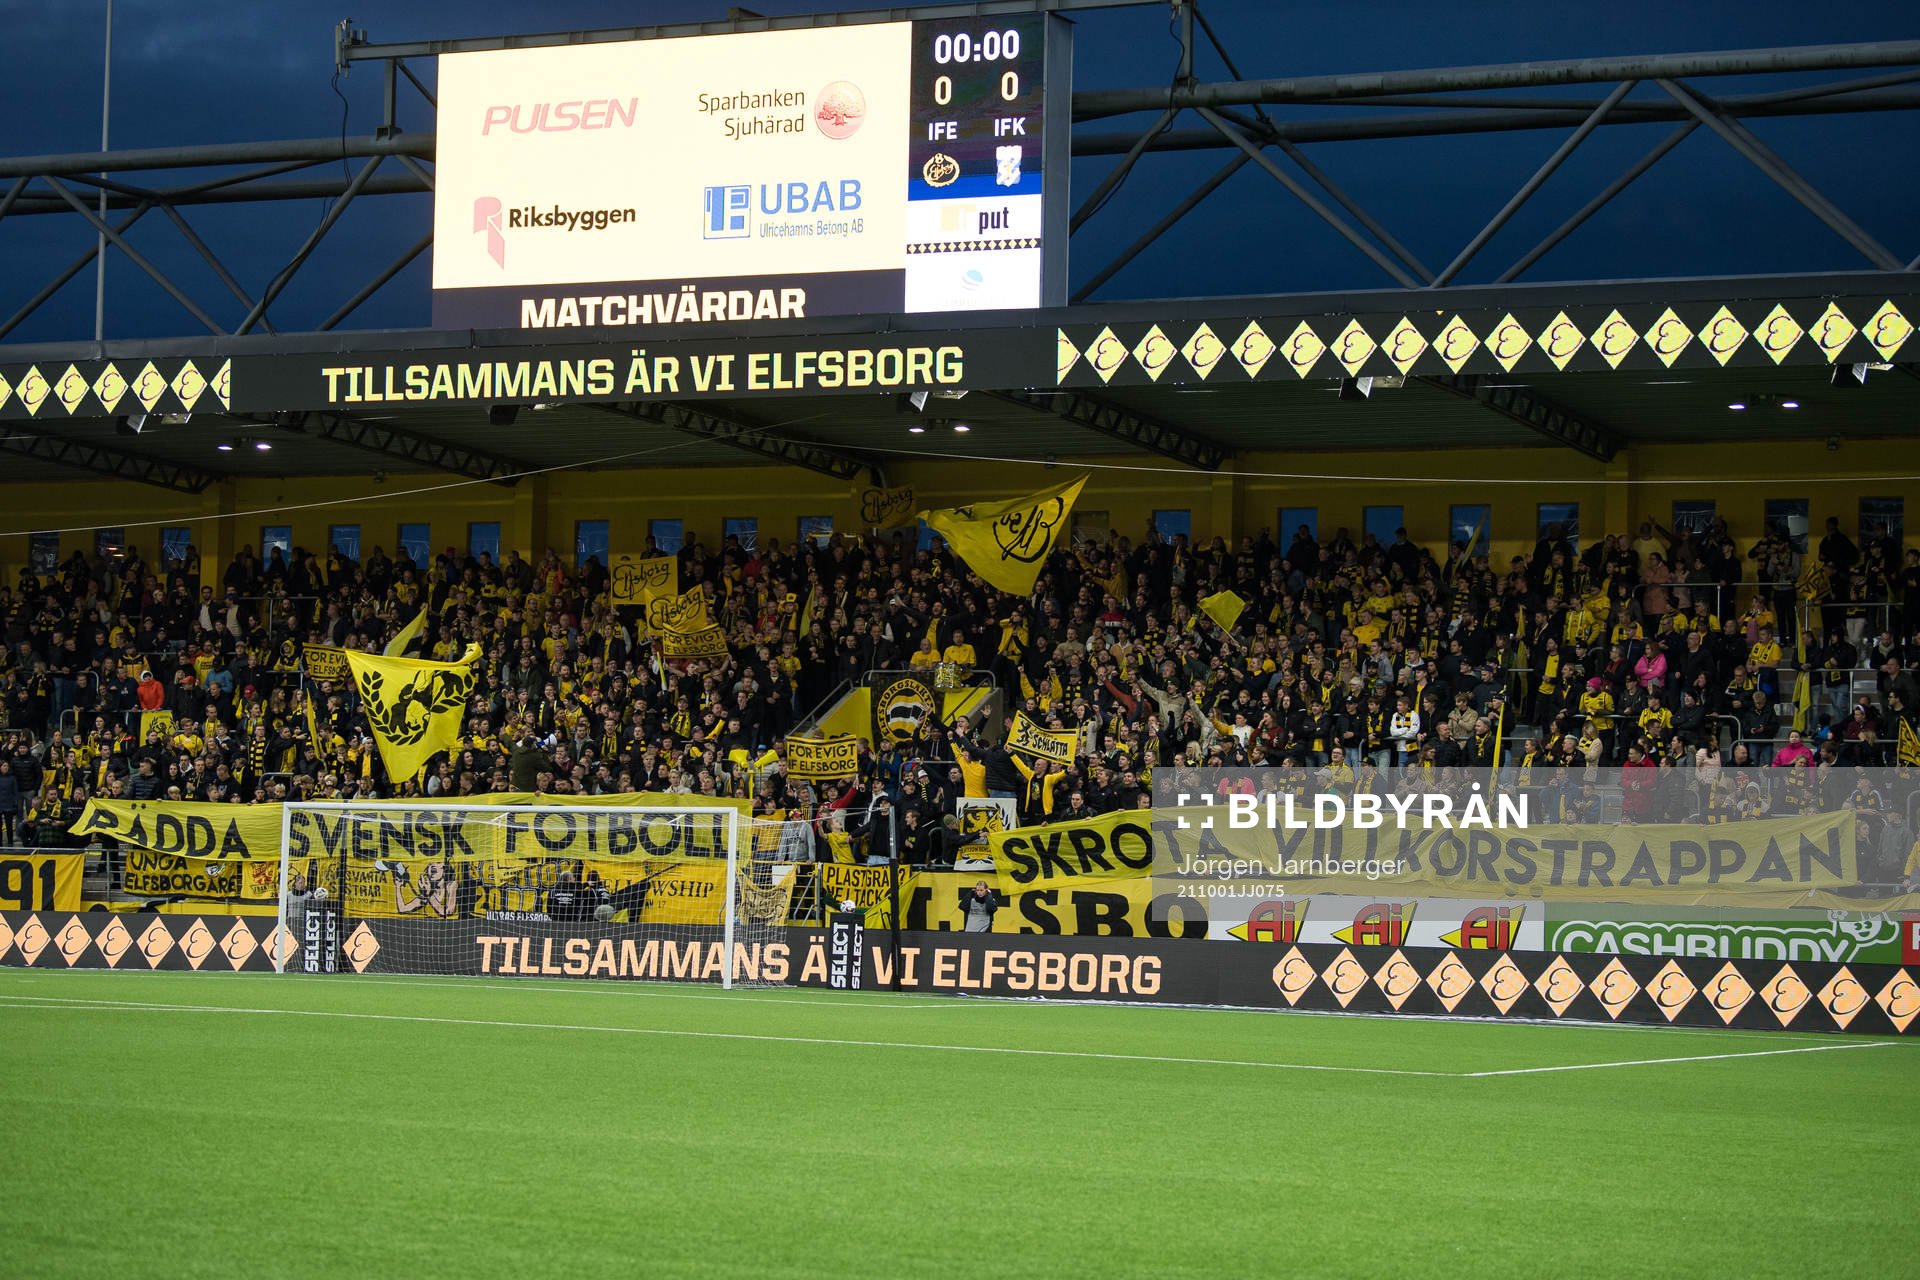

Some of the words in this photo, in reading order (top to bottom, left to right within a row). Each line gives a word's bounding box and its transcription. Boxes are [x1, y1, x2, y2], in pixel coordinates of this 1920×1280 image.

[934, 29, 1020, 64] 00:00
[698, 89, 805, 113] Sparbanken
[934, 75, 952, 106] 0
[1001, 70, 1019, 101] 0
[482, 97, 639, 137] PULSEN
[724, 114, 805, 141] Sjuhärad
[928, 121, 958, 141] IFE
[994, 117, 1026, 137] IFK
[759, 179, 863, 215] UBAB
[509, 206, 637, 232] Riksbyggen
[759, 221, 814, 239] Ulricehamns
[816, 219, 848, 238] Betong
[851, 218, 864, 234] AB
[978, 206, 1010, 235] put
[521, 284, 806, 329] MATCHVÄRDAR
[321, 358, 614, 403] TILLSAMMANS
[624, 349, 679, 394] ÄR
[690, 354, 735, 392] VI
[747, 346, 963, 390] ELFSBORG
[672, 641, 725, 654] ELFSBORG
[684, 630, 720, 646] EVIGT
[313, 664, 349, 675] ELFSBOR
[788, 759, 797, 770] IF
[800, 759, 856, 772] ELFSBORG
[815, 743, 856, 759] EVIGT
[289, 810, 475, 859] SVENSK
[505, 803, 740, 858] FOTBOLL
[130, 850, 188, 872] UNGA
[1002, 820, 1240, 884] SKROTA
[827, 866, 906, 887] PLASTGRÄ?
[304, 909, 321, 972] SELECT
[325, 910, 336, 973] SELECT
[830, 922, 849, 988] SELECT
[1562, 930, 1850, 963] CASHBUDDY
[476, 936, 790, 981] TILLSAMMANS
[800, 935, 828, 983] Ä
[871, 946, 921, 986] VI
[933, 948, 1163, 995] ELFSBORG
[851, 923, 864, 990] SELECT
